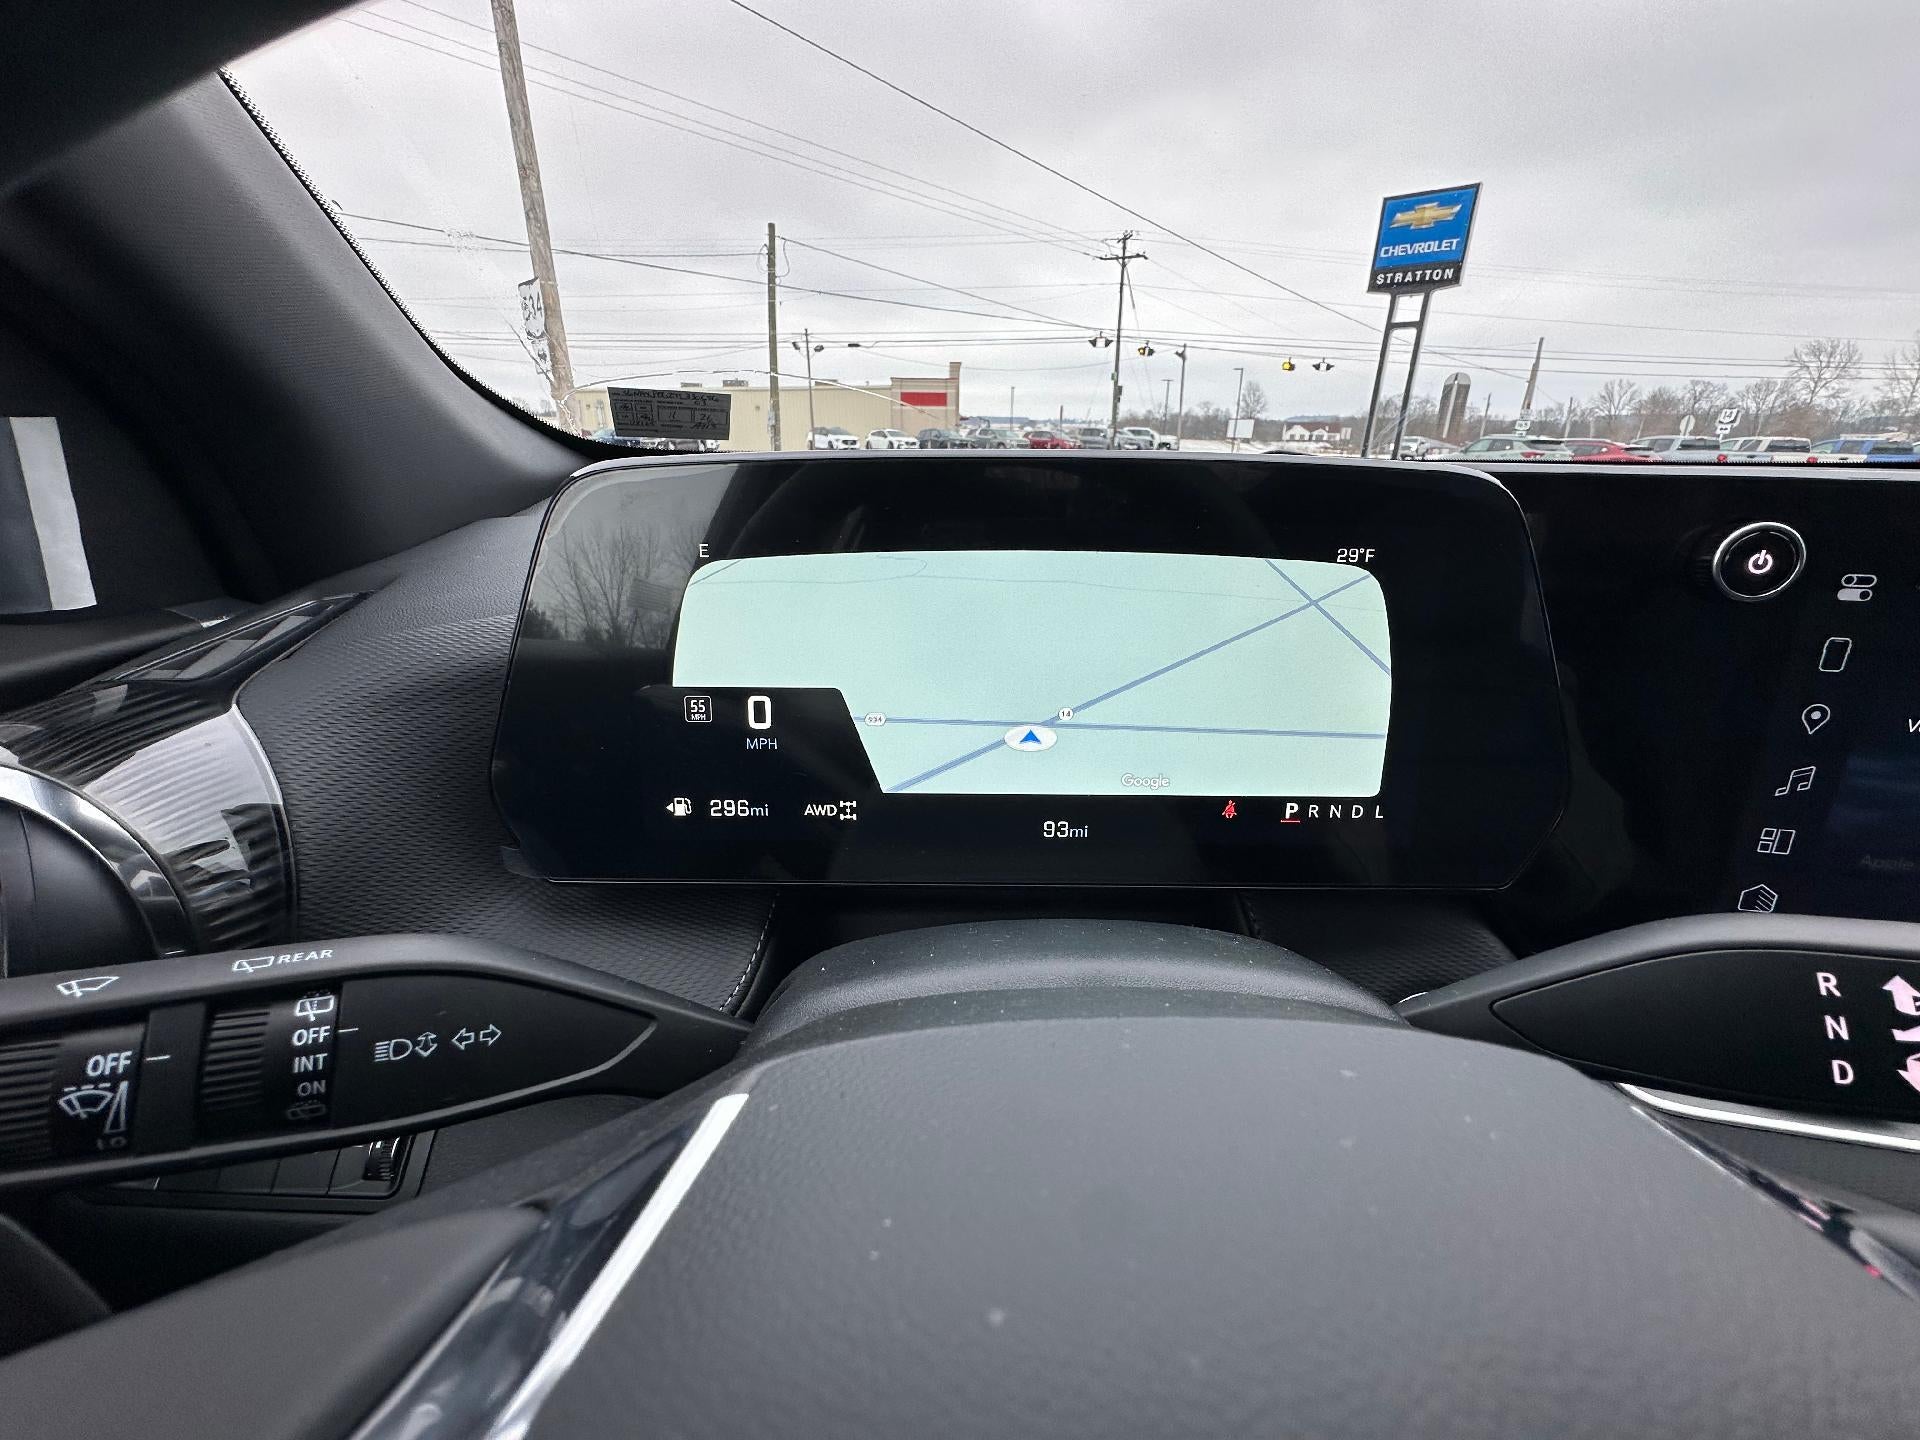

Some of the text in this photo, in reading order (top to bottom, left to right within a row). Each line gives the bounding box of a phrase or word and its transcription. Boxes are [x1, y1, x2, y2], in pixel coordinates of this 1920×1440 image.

[1380, 238, 1461, 258] CHEVROLET
[1375, 268, 1454, 285] STRATTON
[699, 543, 710, 558] E
[1336, 547, 1376, 563] 29°F
[690, 700, 706, 713] 55
[747, 695, 772, 730] 0
[1061, 710, 1071, 718] 14
[691, 713, 706, 721] MPH
[746, 737, 778, 750] MPH
[1121, 772, 1171, 790] Google
[710, 799, 769, 817] 296mi
[804, 803, 838, 817] AWD
[1285, 802, 1384, 819] P R N D L
[1043, 820, 1089, 838] 93mi
[277, 949, 334, 965] REAR
[1816, 971, 1842, 997] R
[292, 1025, 331, 1047] OFF
[1824, 1014, 1849, 1041] N
[86, 1050, 133, 1077] OFF
[293, 1052, 328, 1074] INT
[1831, 1059, 1854, 1085] D
[297, 1079, 327, 1097] ON
